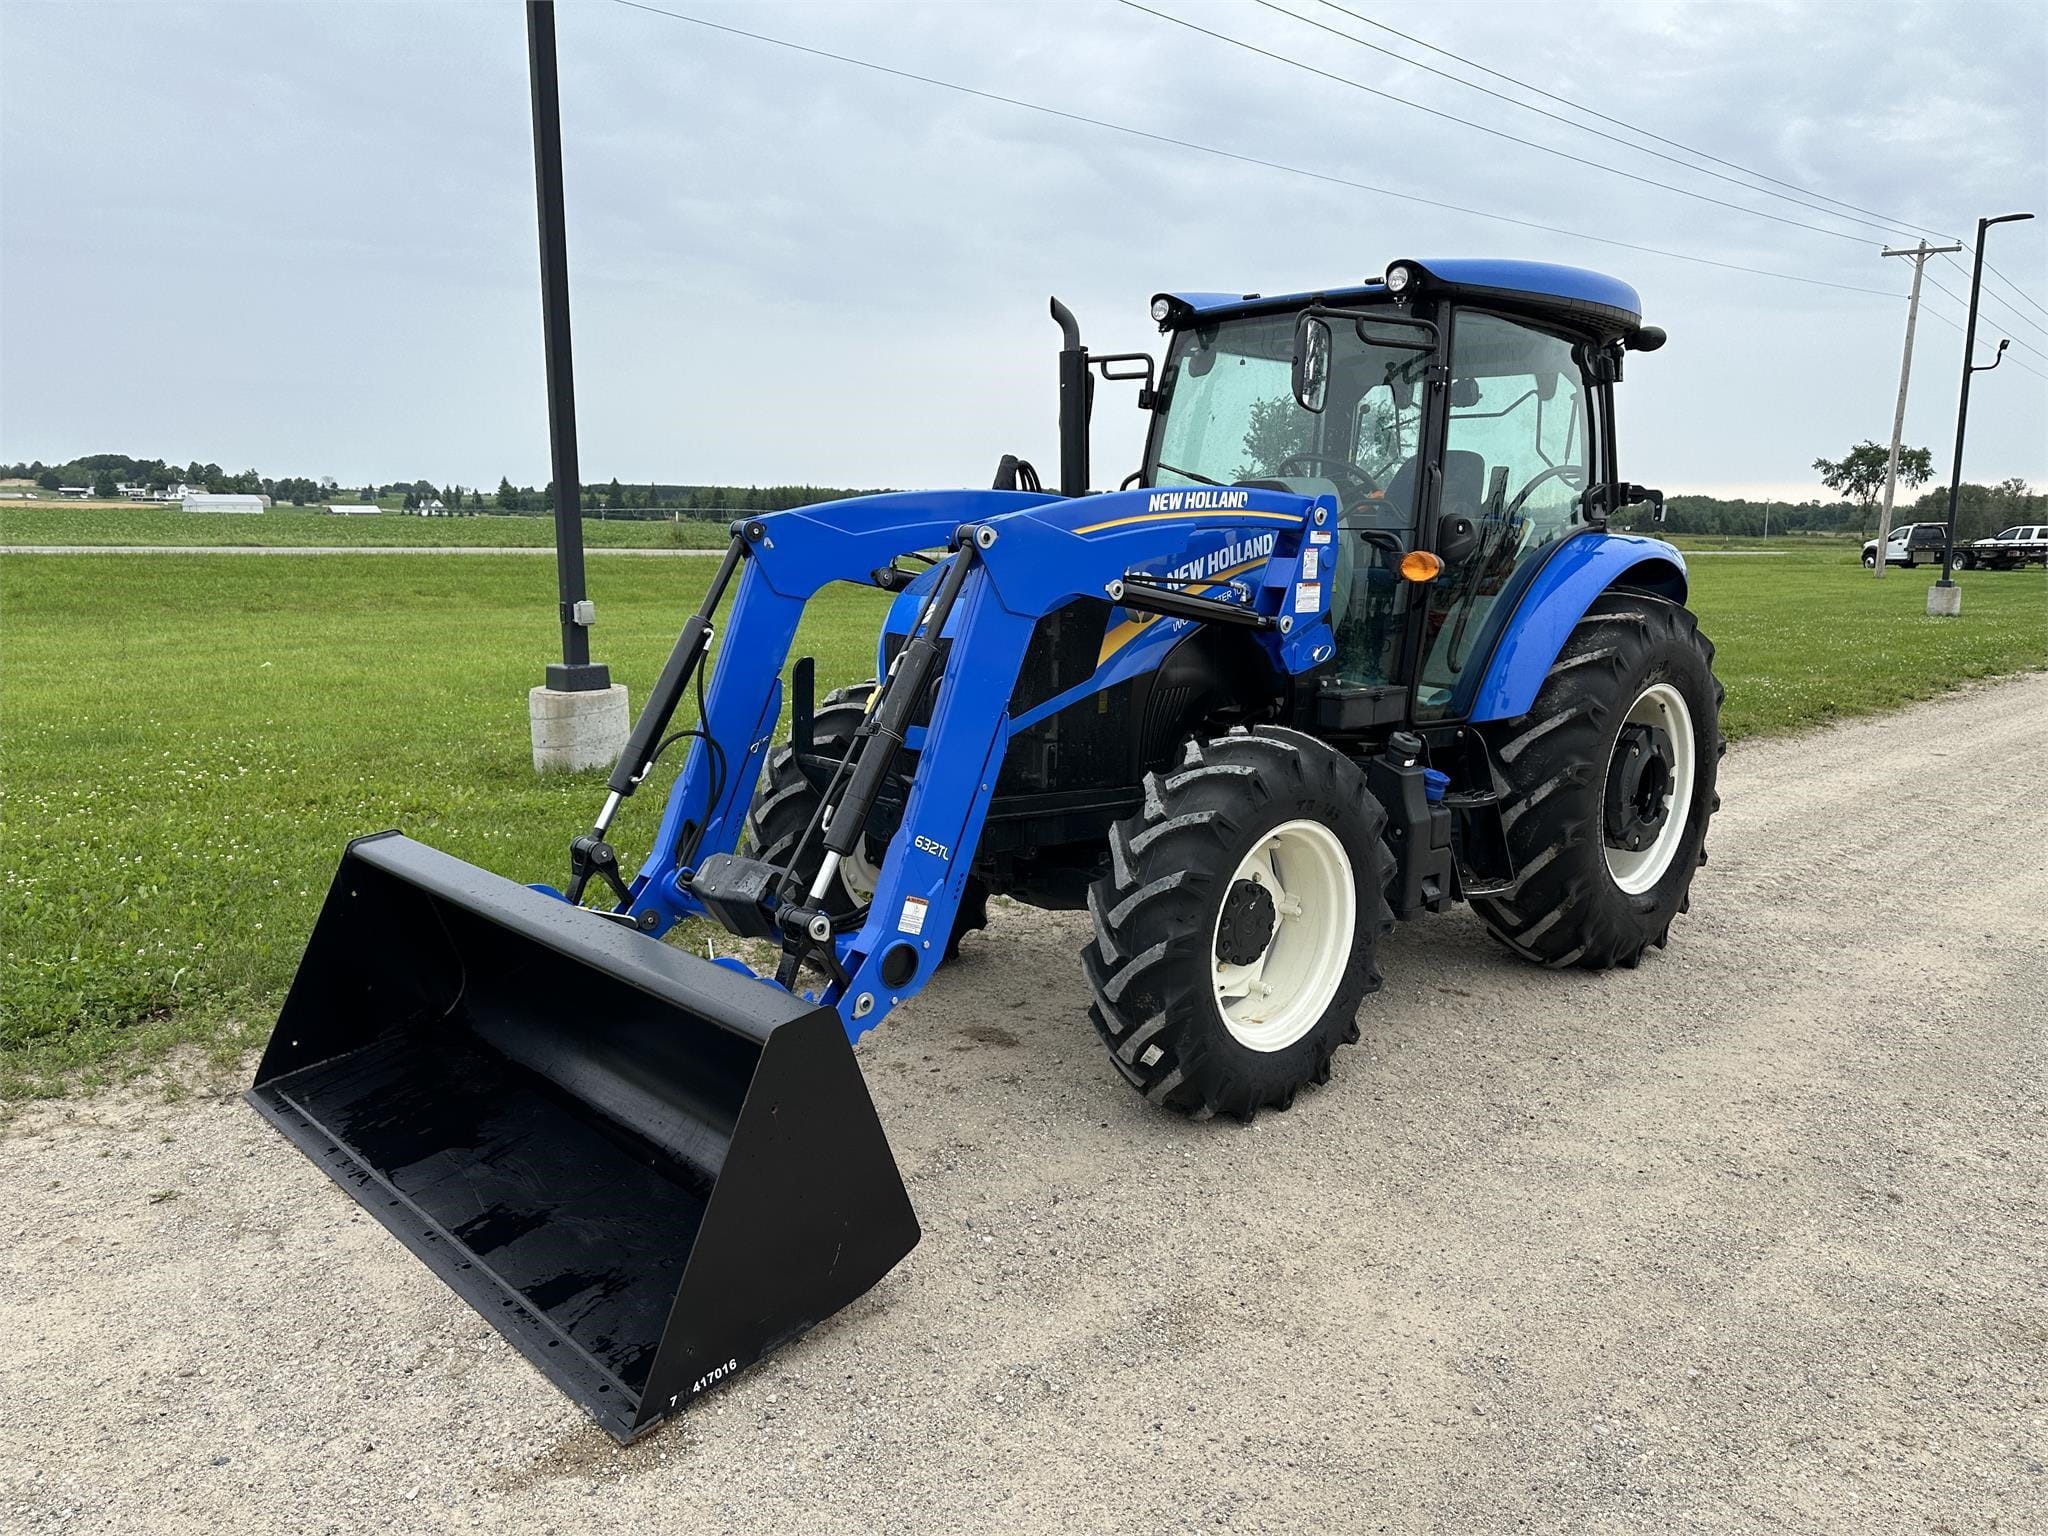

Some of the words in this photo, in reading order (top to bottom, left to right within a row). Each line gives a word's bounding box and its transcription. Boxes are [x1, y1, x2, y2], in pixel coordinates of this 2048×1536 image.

[1148, 492, 1184, 512] NEW
[1184, 491, 1248, 509] HOLLAND
[1167, 556, 1205, 591] NEW
[1207, 533, 1273, 575] HOLLAND
[914, 835, 949, 861] 632TL
